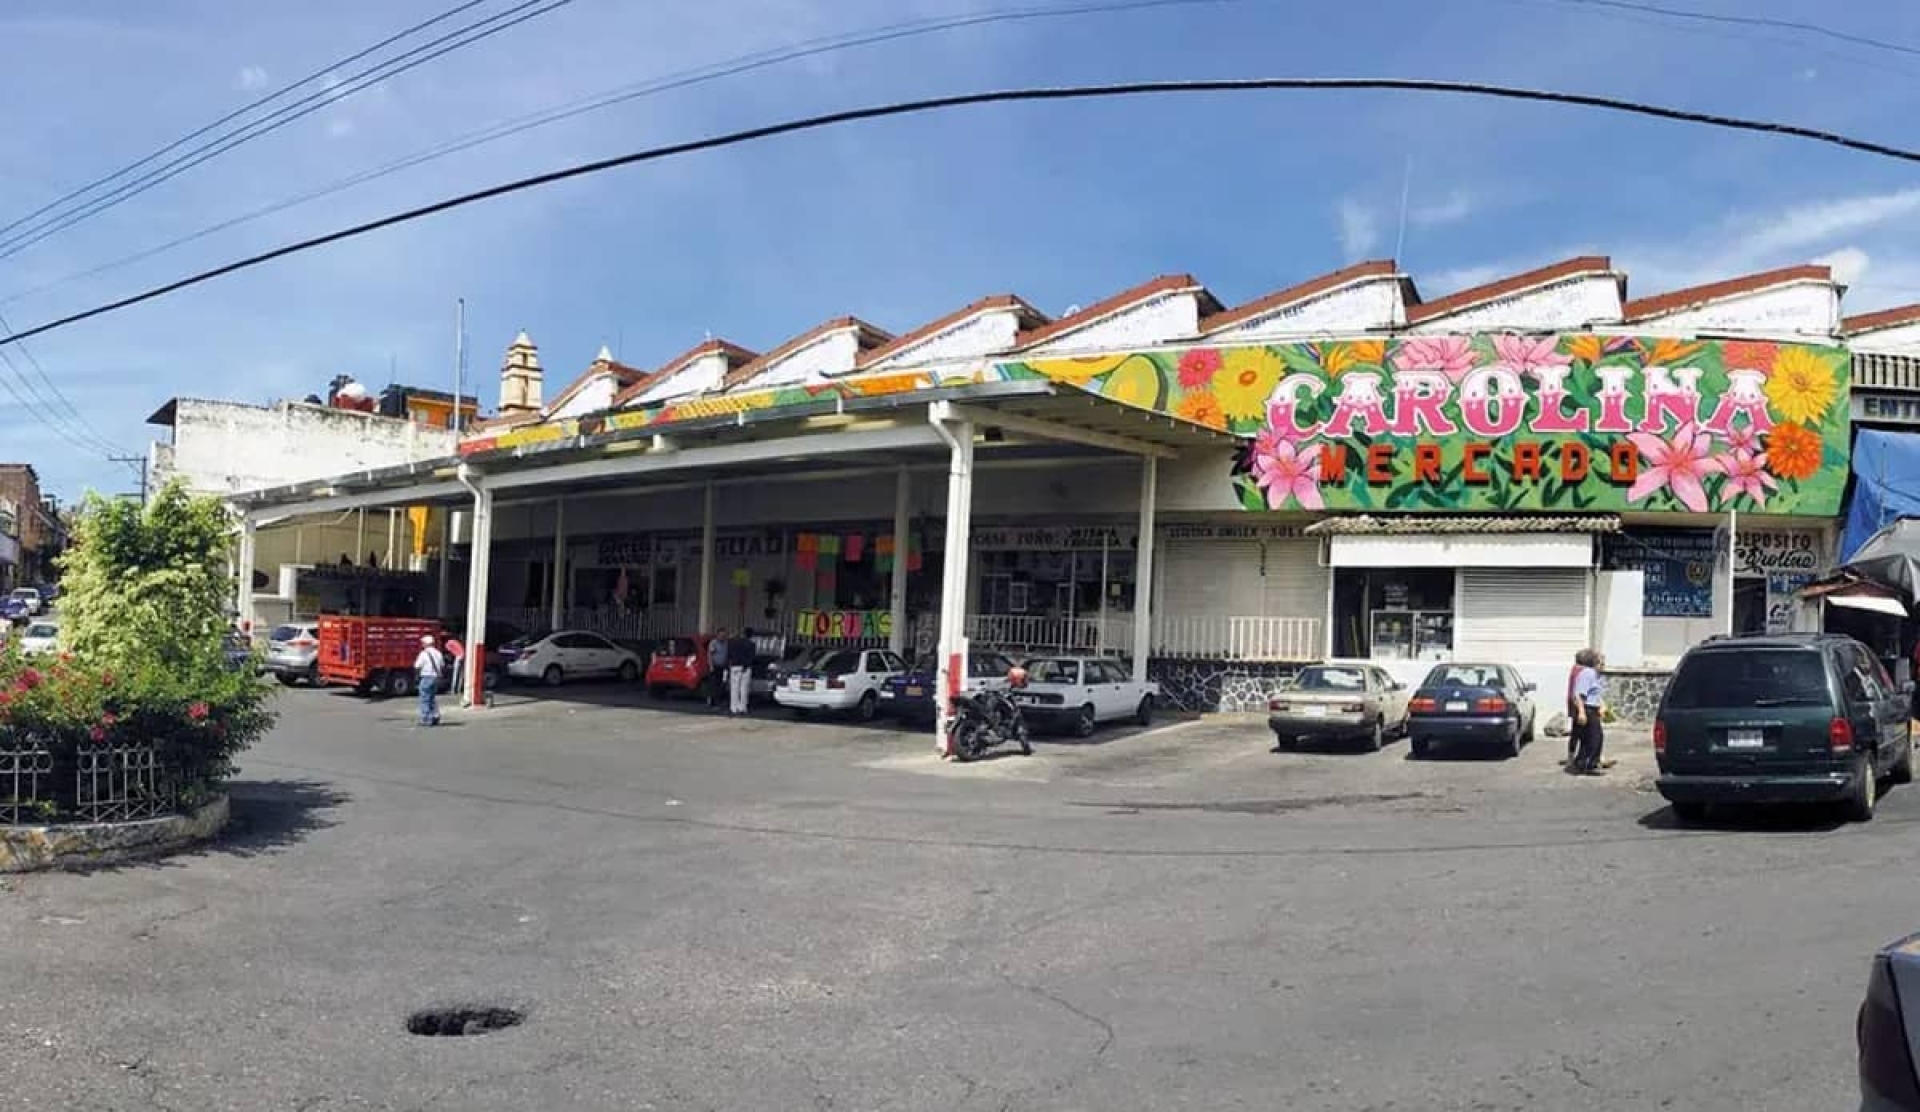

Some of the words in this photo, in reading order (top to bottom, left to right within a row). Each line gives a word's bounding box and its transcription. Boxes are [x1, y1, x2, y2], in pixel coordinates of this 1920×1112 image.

[1264, 364, 1777, 440] CAROLINA
[1319, 442, 1638, 484] MERCADO
[797, 610, 892, 635] TORTAS
